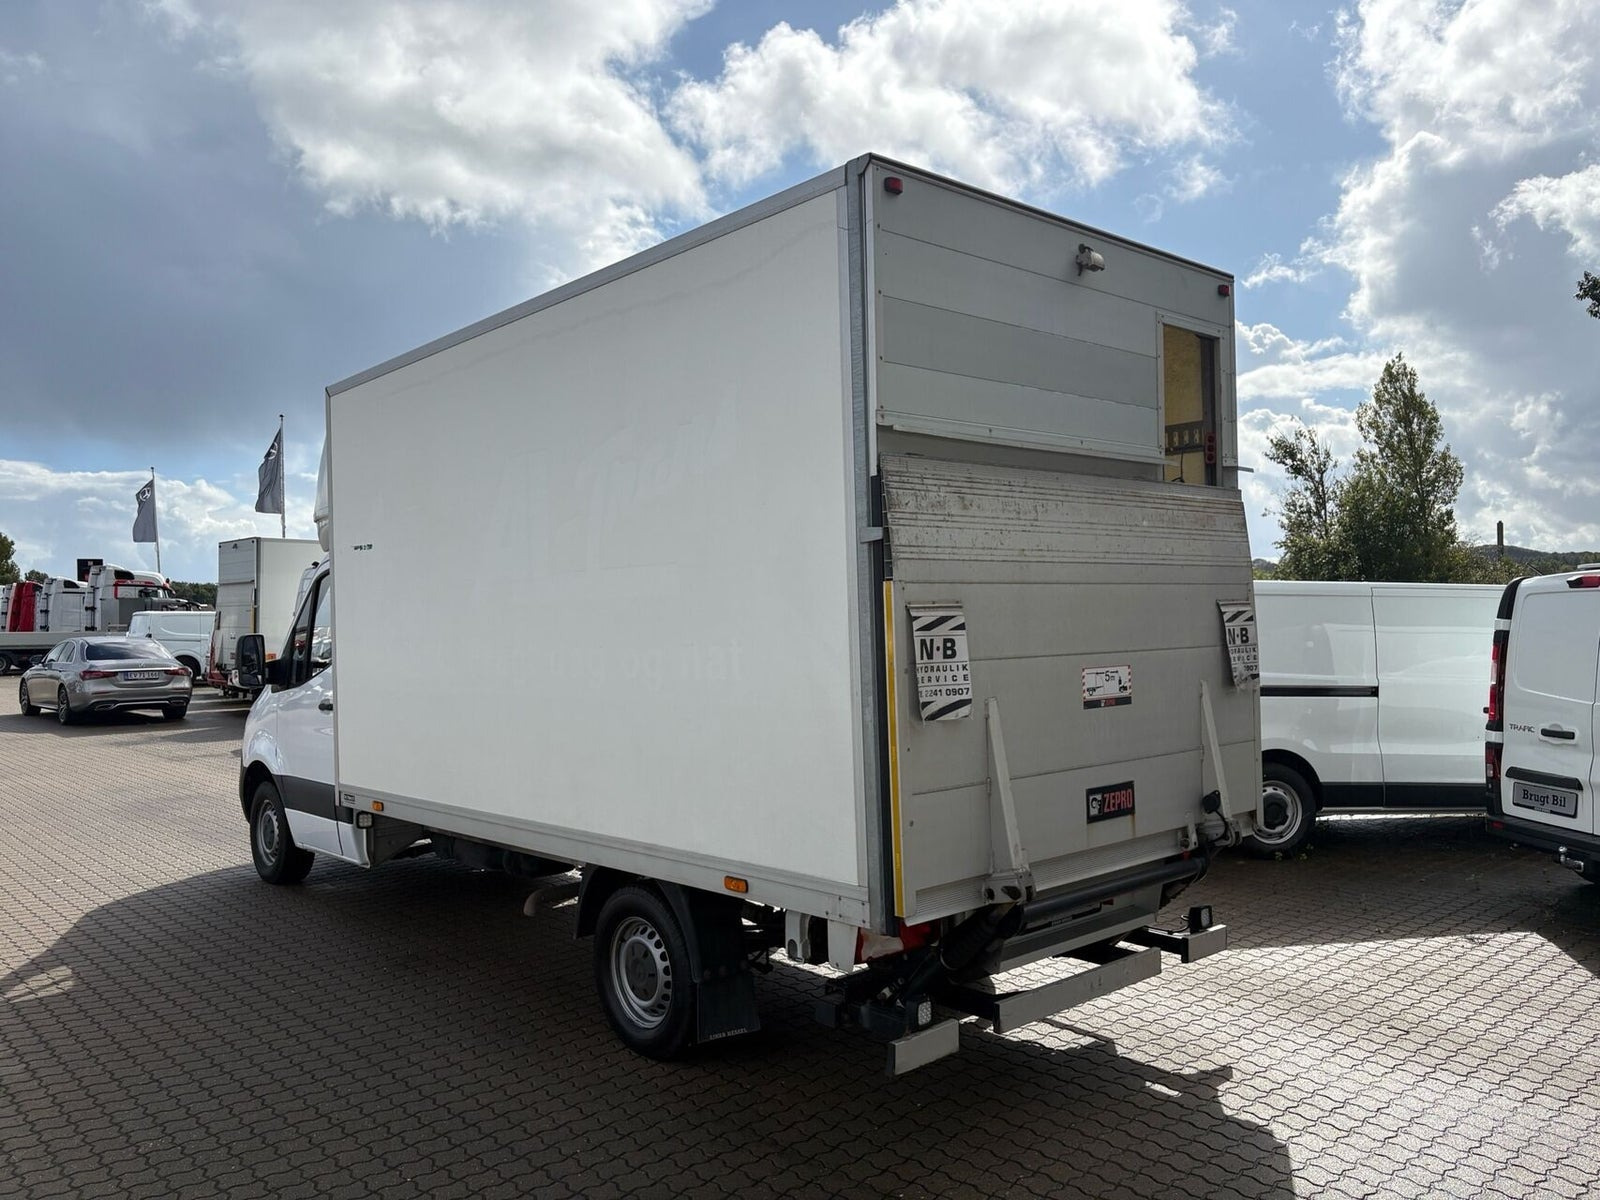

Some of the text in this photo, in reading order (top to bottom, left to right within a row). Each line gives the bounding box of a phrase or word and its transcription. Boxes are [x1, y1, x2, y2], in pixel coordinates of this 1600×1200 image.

[918, 674, 969, 684] ERVICE
[1509, 723, 1535, 733] TRAFIC
[1103, 789, 1133, 813] ZEPRO
[1522, 789, 1566, 808] Brugt Bil
